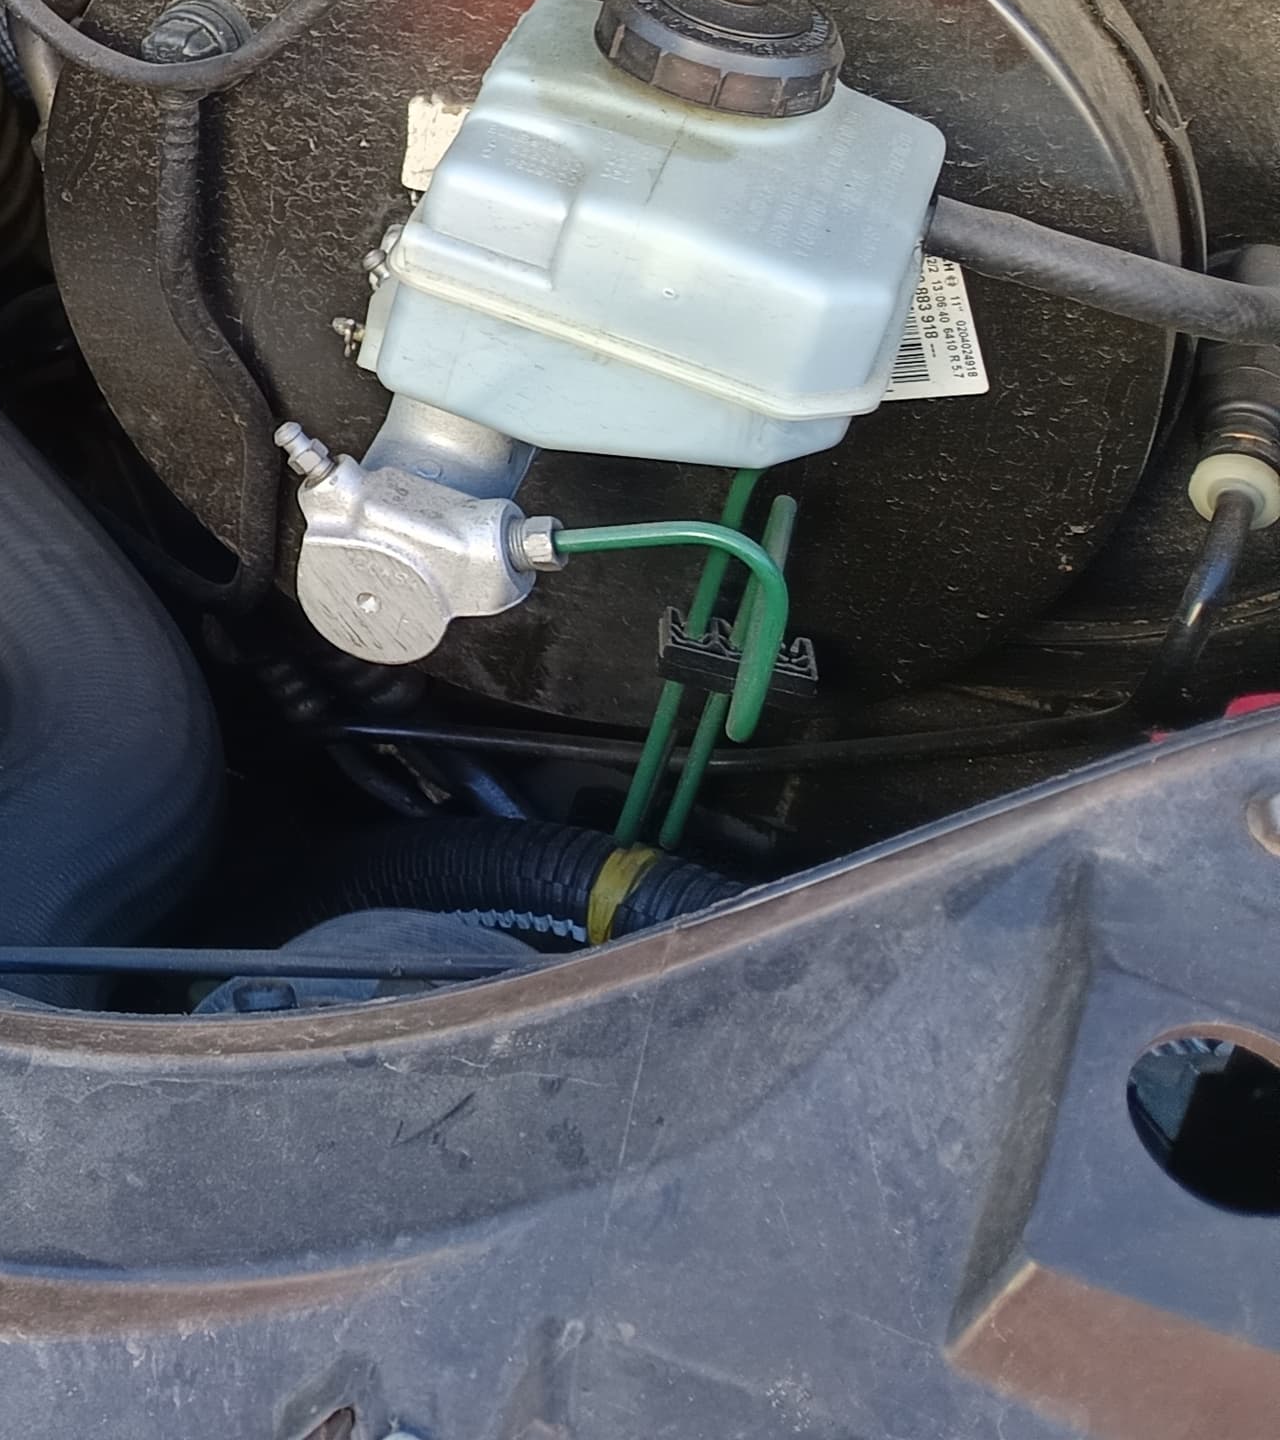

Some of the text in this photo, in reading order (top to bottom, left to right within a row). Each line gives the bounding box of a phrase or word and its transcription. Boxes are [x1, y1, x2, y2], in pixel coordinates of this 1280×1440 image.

[921, 315, 939, 339] 918
[943, 327, 958, 351] 6410
[949, 355, 961, 363] R
[956, 320, 979, 378] 0204024918
[951, 364, 965, 379] 5.7
